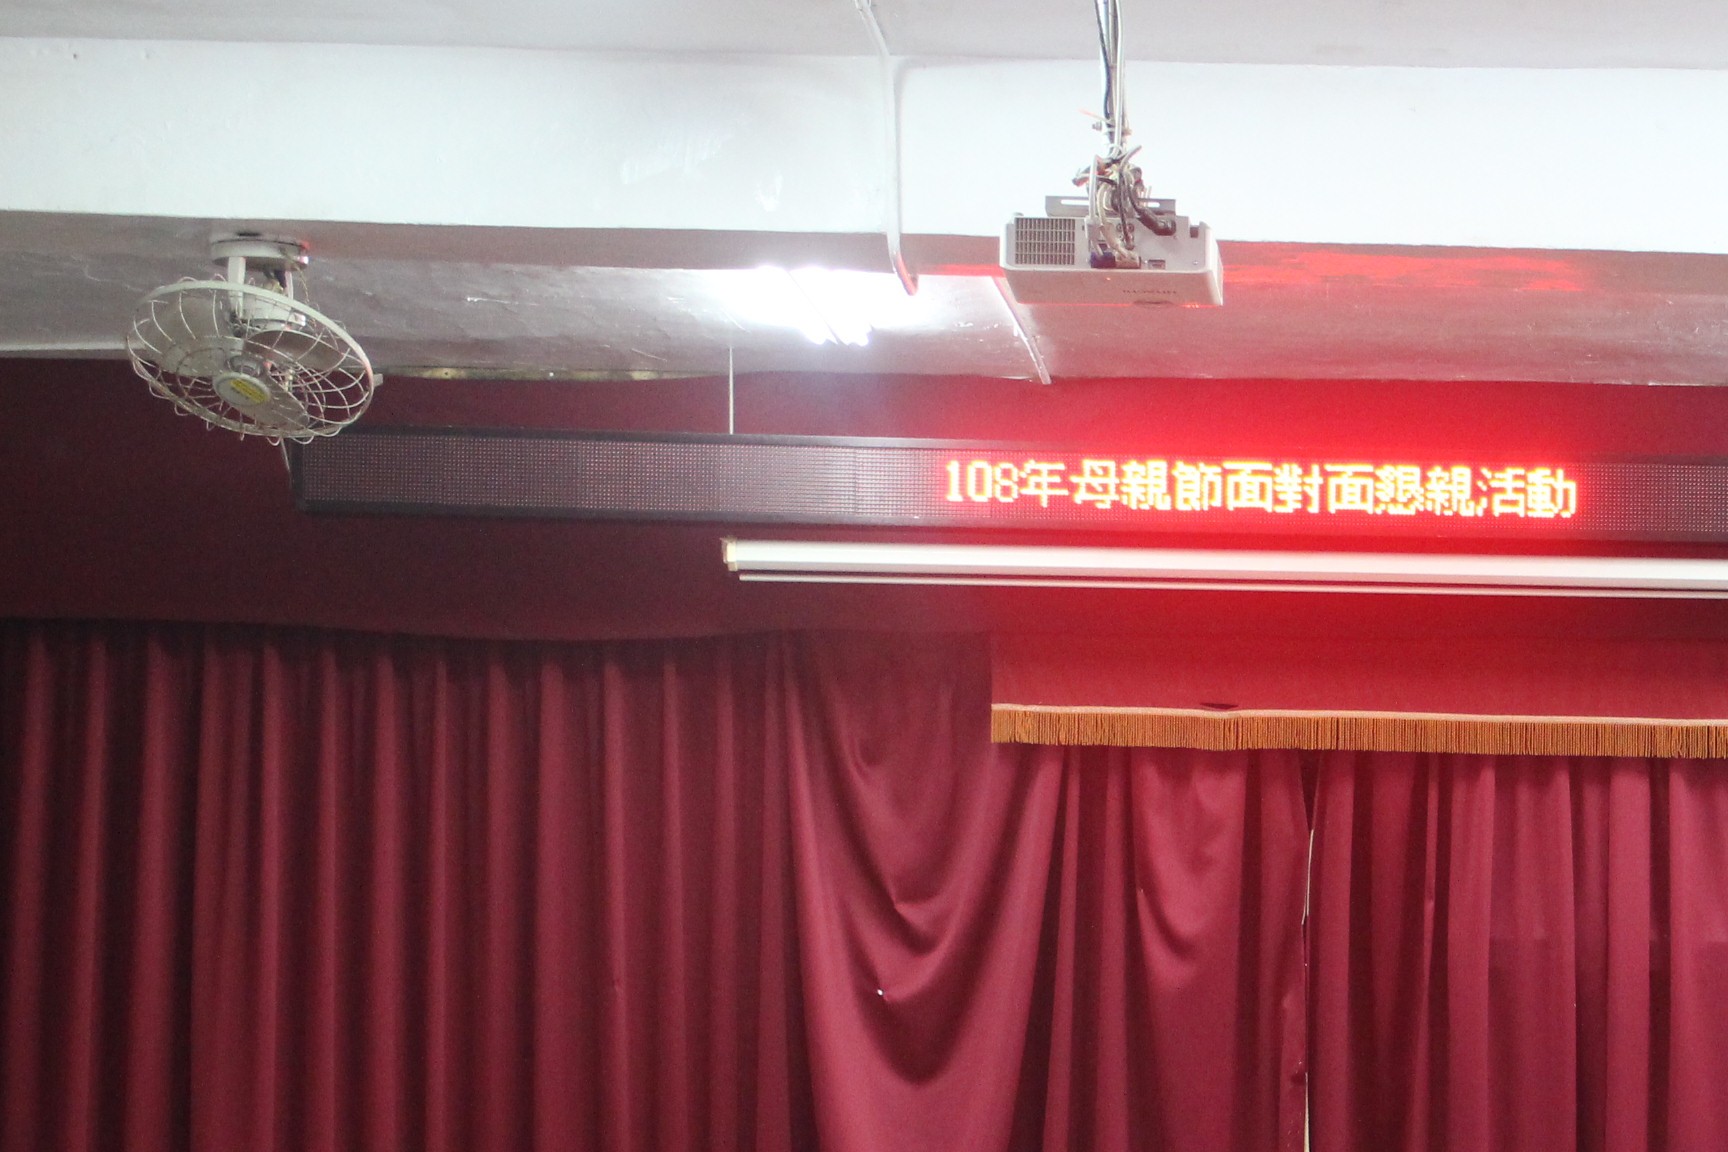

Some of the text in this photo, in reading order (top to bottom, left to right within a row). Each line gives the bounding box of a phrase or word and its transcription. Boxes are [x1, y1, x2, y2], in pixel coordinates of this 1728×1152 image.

[945, 458, 1579, 519] 108年母親節面對面懇親活動
